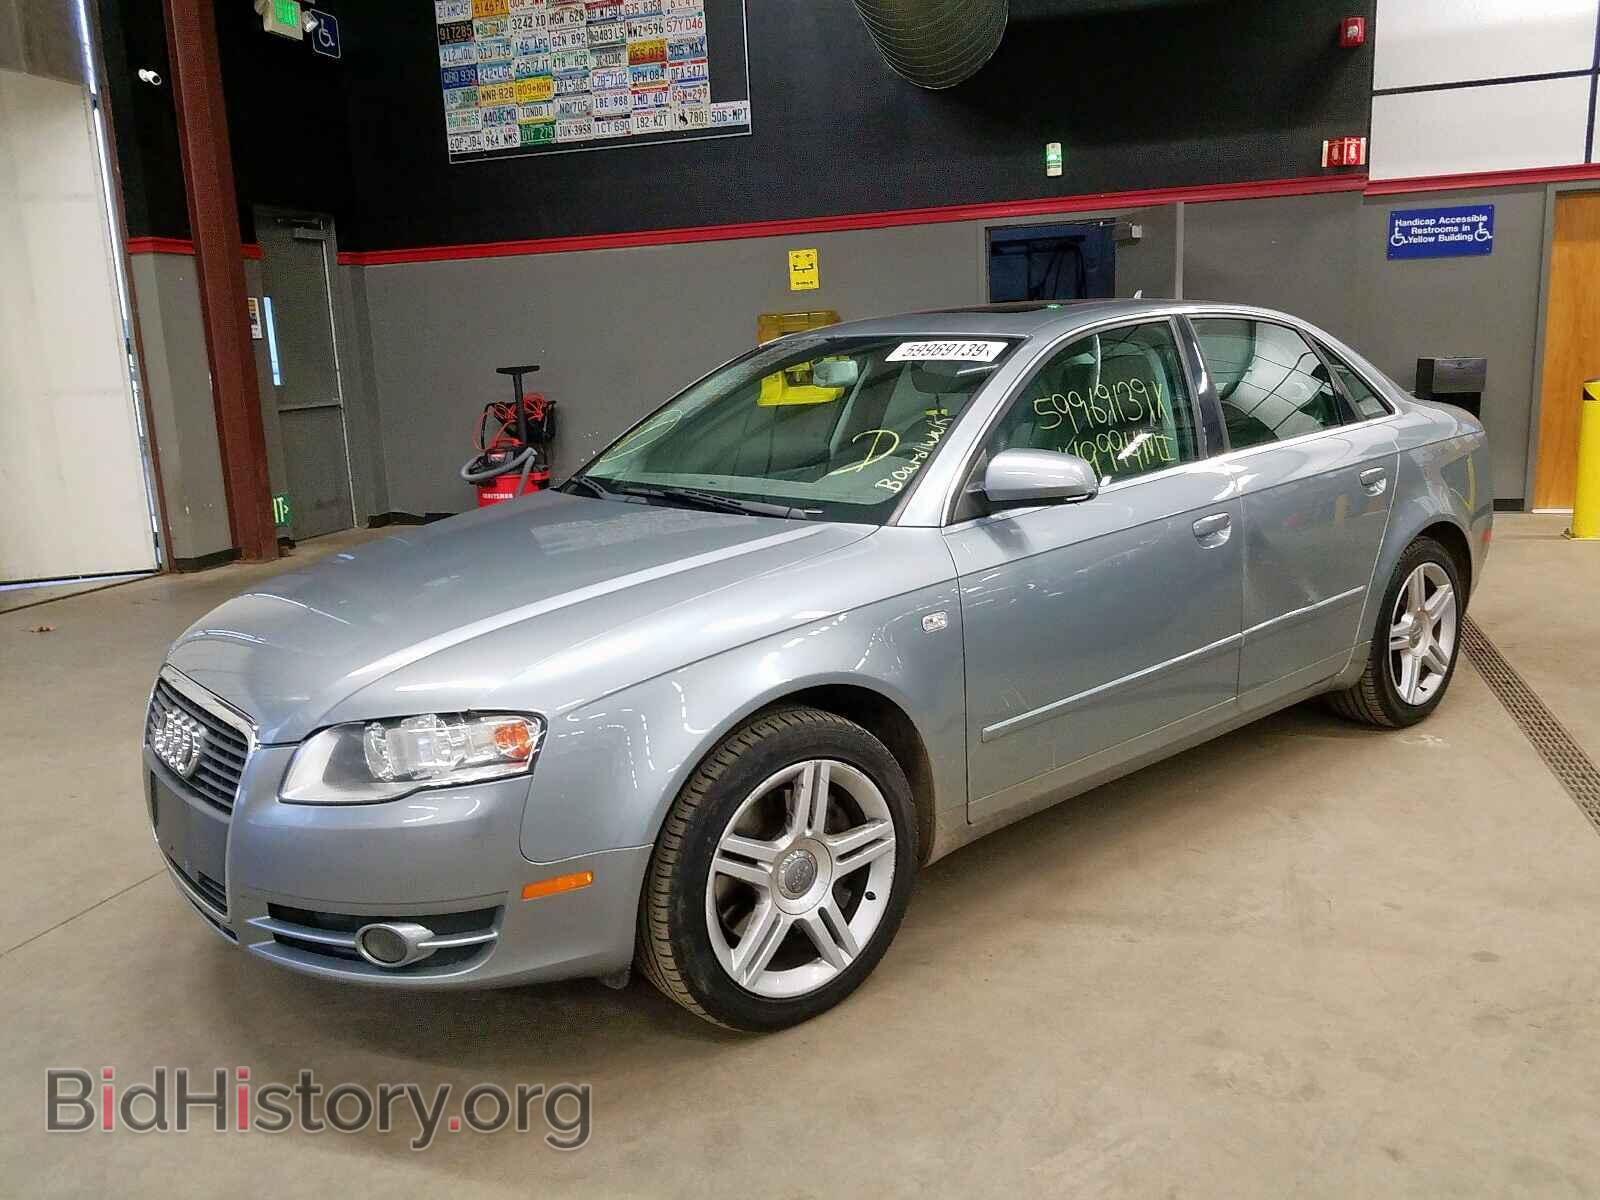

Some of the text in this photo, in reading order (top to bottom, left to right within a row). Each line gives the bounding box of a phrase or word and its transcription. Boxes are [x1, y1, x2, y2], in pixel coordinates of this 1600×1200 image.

[571, 33, 586, 46] 892
[1395, 214, 1488, 227] Handicap Accessible
[1411, 224, 1471, 235] Restrooms in
[1407, 233, 1474, 244] Yellow Building
